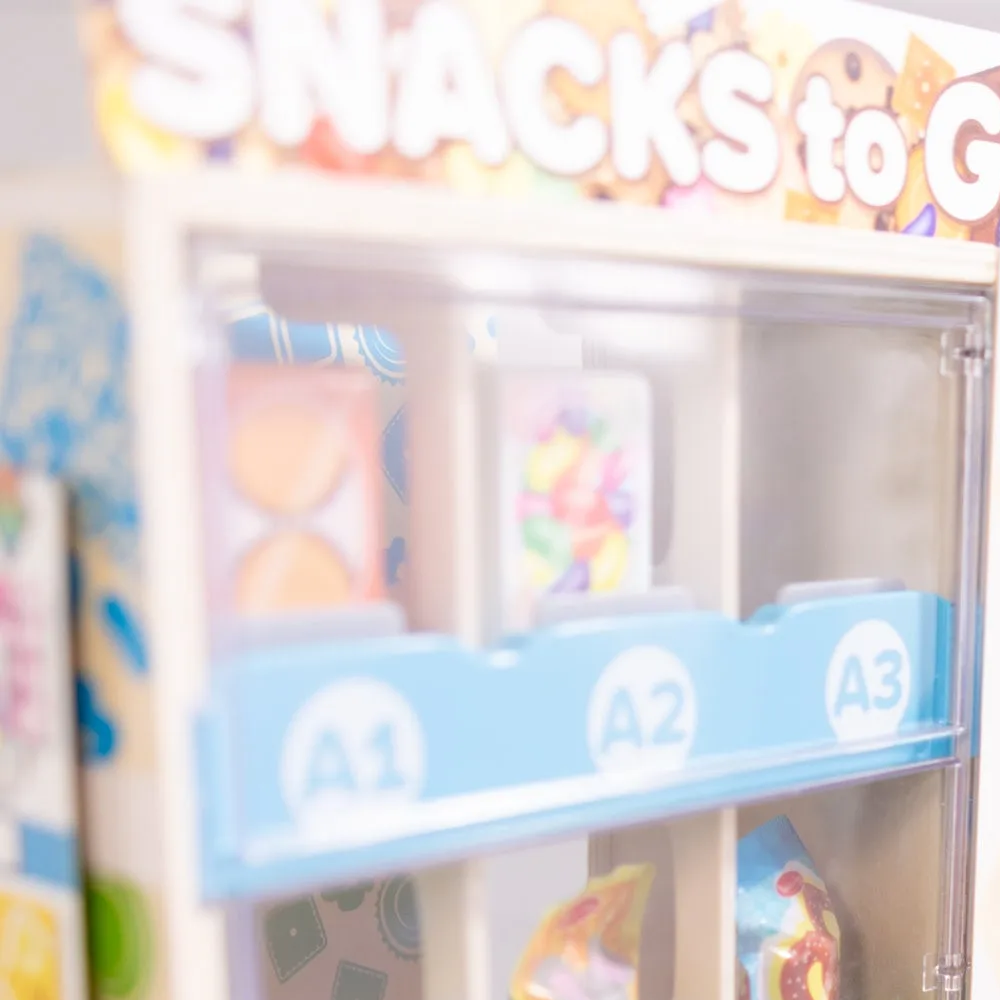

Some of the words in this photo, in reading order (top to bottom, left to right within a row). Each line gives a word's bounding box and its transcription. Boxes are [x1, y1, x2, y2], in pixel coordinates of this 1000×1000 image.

[115, 0, 779, 194] SNACKS
[796, 74, 907, 206] to
[303, 722, 405, 798] A1
[603, 680, 688, 752] A2
[834, 647, 902, 720] A3
